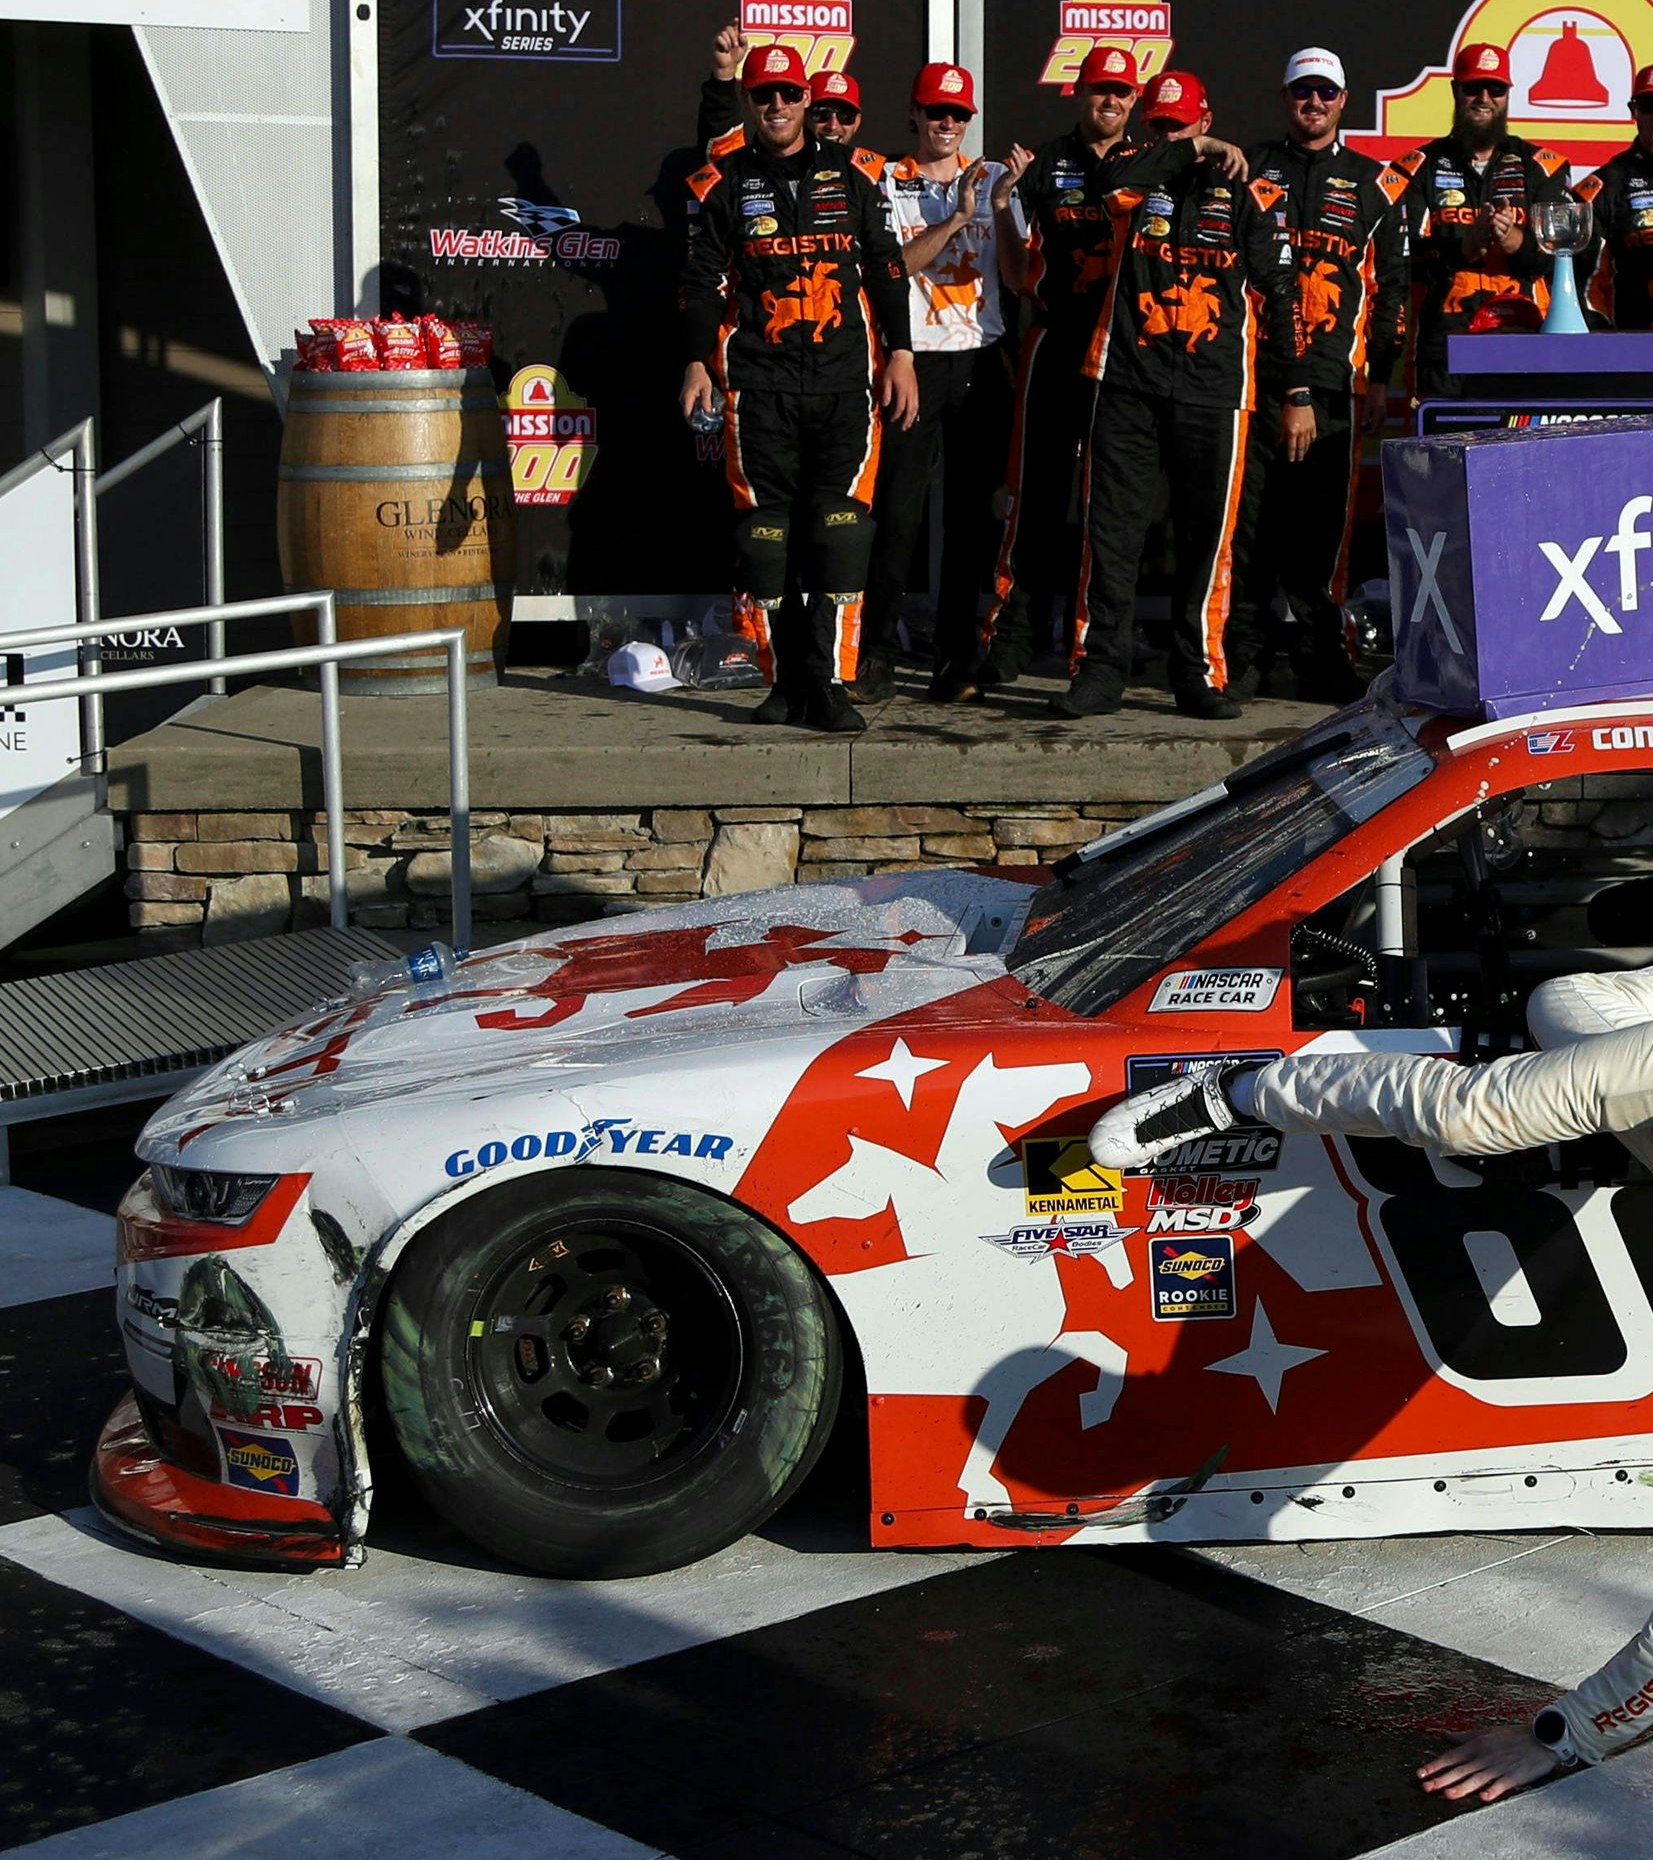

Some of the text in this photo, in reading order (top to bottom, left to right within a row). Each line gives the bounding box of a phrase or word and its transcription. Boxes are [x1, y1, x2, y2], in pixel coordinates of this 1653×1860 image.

[464, 0, 591, 44] xfinity
[501, 36, 554, 51] SERIES
[1055, 206, 1104, 222] REGI
[902, 223, 992, 241] RETIX
[430, 228, 620, 259] Watkins Glen
[435, 259, 617, 268] INTERNATIONAL
[512, 444, 598, 491] 00
[532, 492, 561, 503] GLEN
[376, 496, 513, 527] GLENORA
[101, 651, 154, 661] CELLARS
[1193, 973, 1264, 989] NASCAR
[1168, 991, 1256, 1005] RACE CAR
[1156, 1137, 1279, 1166] OMETIC
[1140, 1165, 1196, 1175] GASKET
[1149, 1177, 1259, 1210] Holley
[1029, 1196, 1120, 1212] KENNAMETAL
[1147, 1208, 1244, 1233] MSD
[1012, 1224, 1109, 1243] FIVE STAR
[1160, 1259, 1224, 1273] SUNOCO
[1159, 1289, 1228, 1303] ROOKIE
[229, 1449, 296, 1473] SUNOCO
